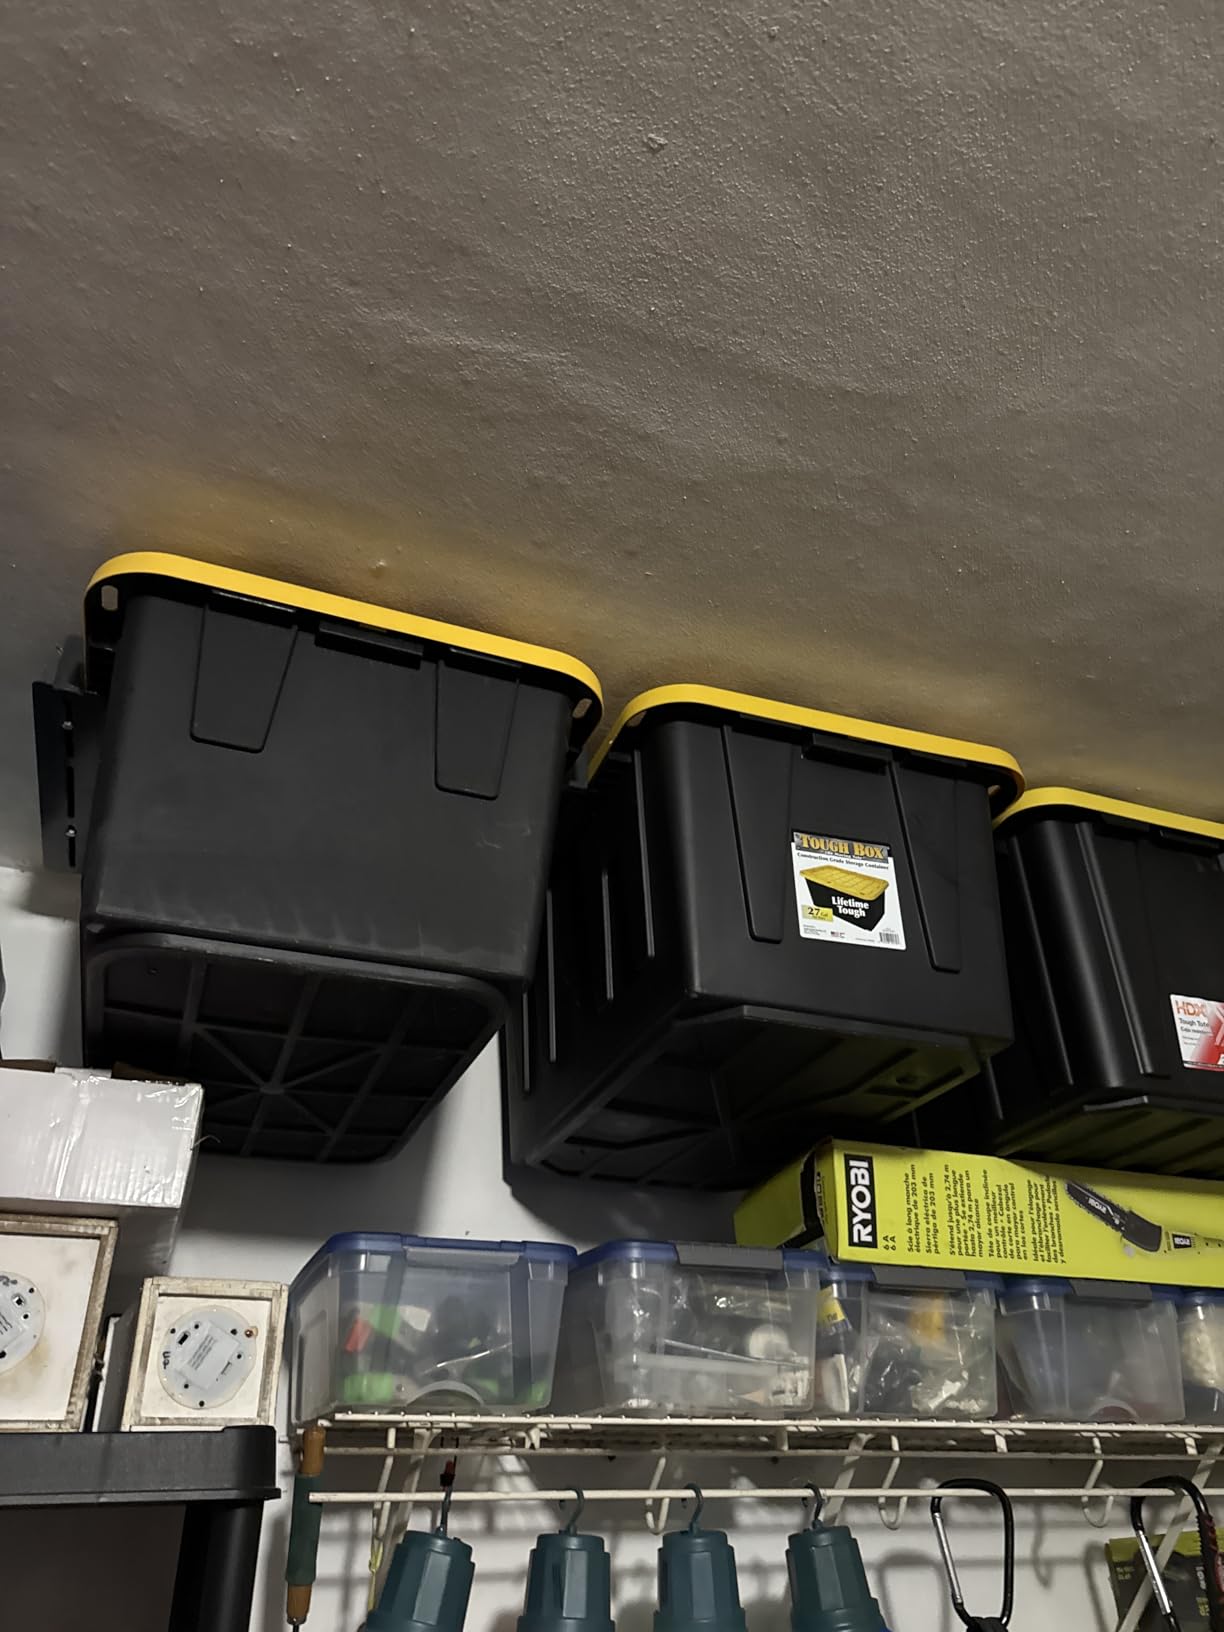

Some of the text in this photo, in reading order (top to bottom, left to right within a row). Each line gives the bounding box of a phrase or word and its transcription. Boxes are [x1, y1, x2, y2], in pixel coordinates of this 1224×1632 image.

[801, 834, 849, 854] TOUGH
[853, 841, 884, 859] BOX
[797, 852, 828, 862] Construction
[832, 896, 869, 909] Lifetime
[808, 907, 820, 916] 27
[837, 906, 866, 918] Tough
[1175, 1000, 1207, 1017] HDX
[910, 1164, 915, 1180] mm
[944, 1164, 949, 1173] m
[921, 1176, 928, 1187] de
[929, 1173, 934, 1189] mm
[965, 1170, 970, 1181] un
[903, 1172, 911, 1205] manche
[951, 1170, 959, 1198] longue
[849, 1160, 872, 1243] RYOBI
[912, 1199, 918, 1210] de
[922, 1189, 930, 1225] eléctrica
[952, 1200, 960, 1217] plus
[968, 1204, 973, 1212] m
[930, 1209, 937, 1220] de
[960, 1210, 966, 1220] Se
[1006, 1214, 1011, 1224] en
[913, 1212, 921, 1253] électrique
[986, 1228, 993, 1238] de
[994, 1226, 999, 1237] un
[956, 1237, 964, 1256] pour
[961, 1229, 969, 1256] portée
[968, 1234, 976, 1257] hasta
[976, 1231, 984, 1258] mayor
[1008, 1249, 1014, 1259] de
[1023, 1250, 1027, 1261] en
[1040, 1254, 1045, 1262] et
